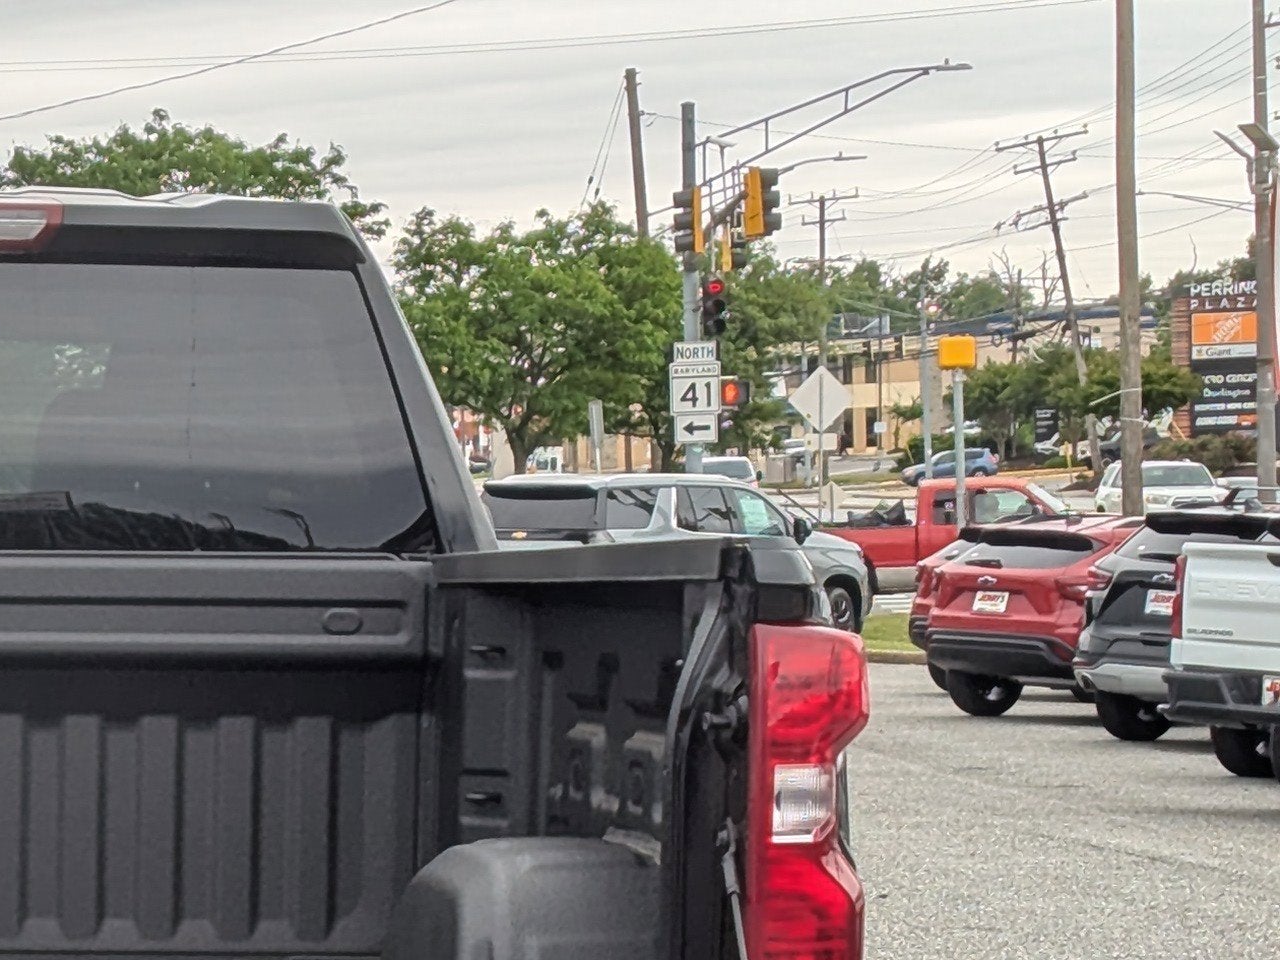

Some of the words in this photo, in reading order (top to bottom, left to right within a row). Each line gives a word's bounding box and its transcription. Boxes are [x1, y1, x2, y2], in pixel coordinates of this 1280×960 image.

[676, 346, 714, 359] NORTH
[673, 366, 717, 375] MARYLAND
[680, 381, 712, 408] 41
